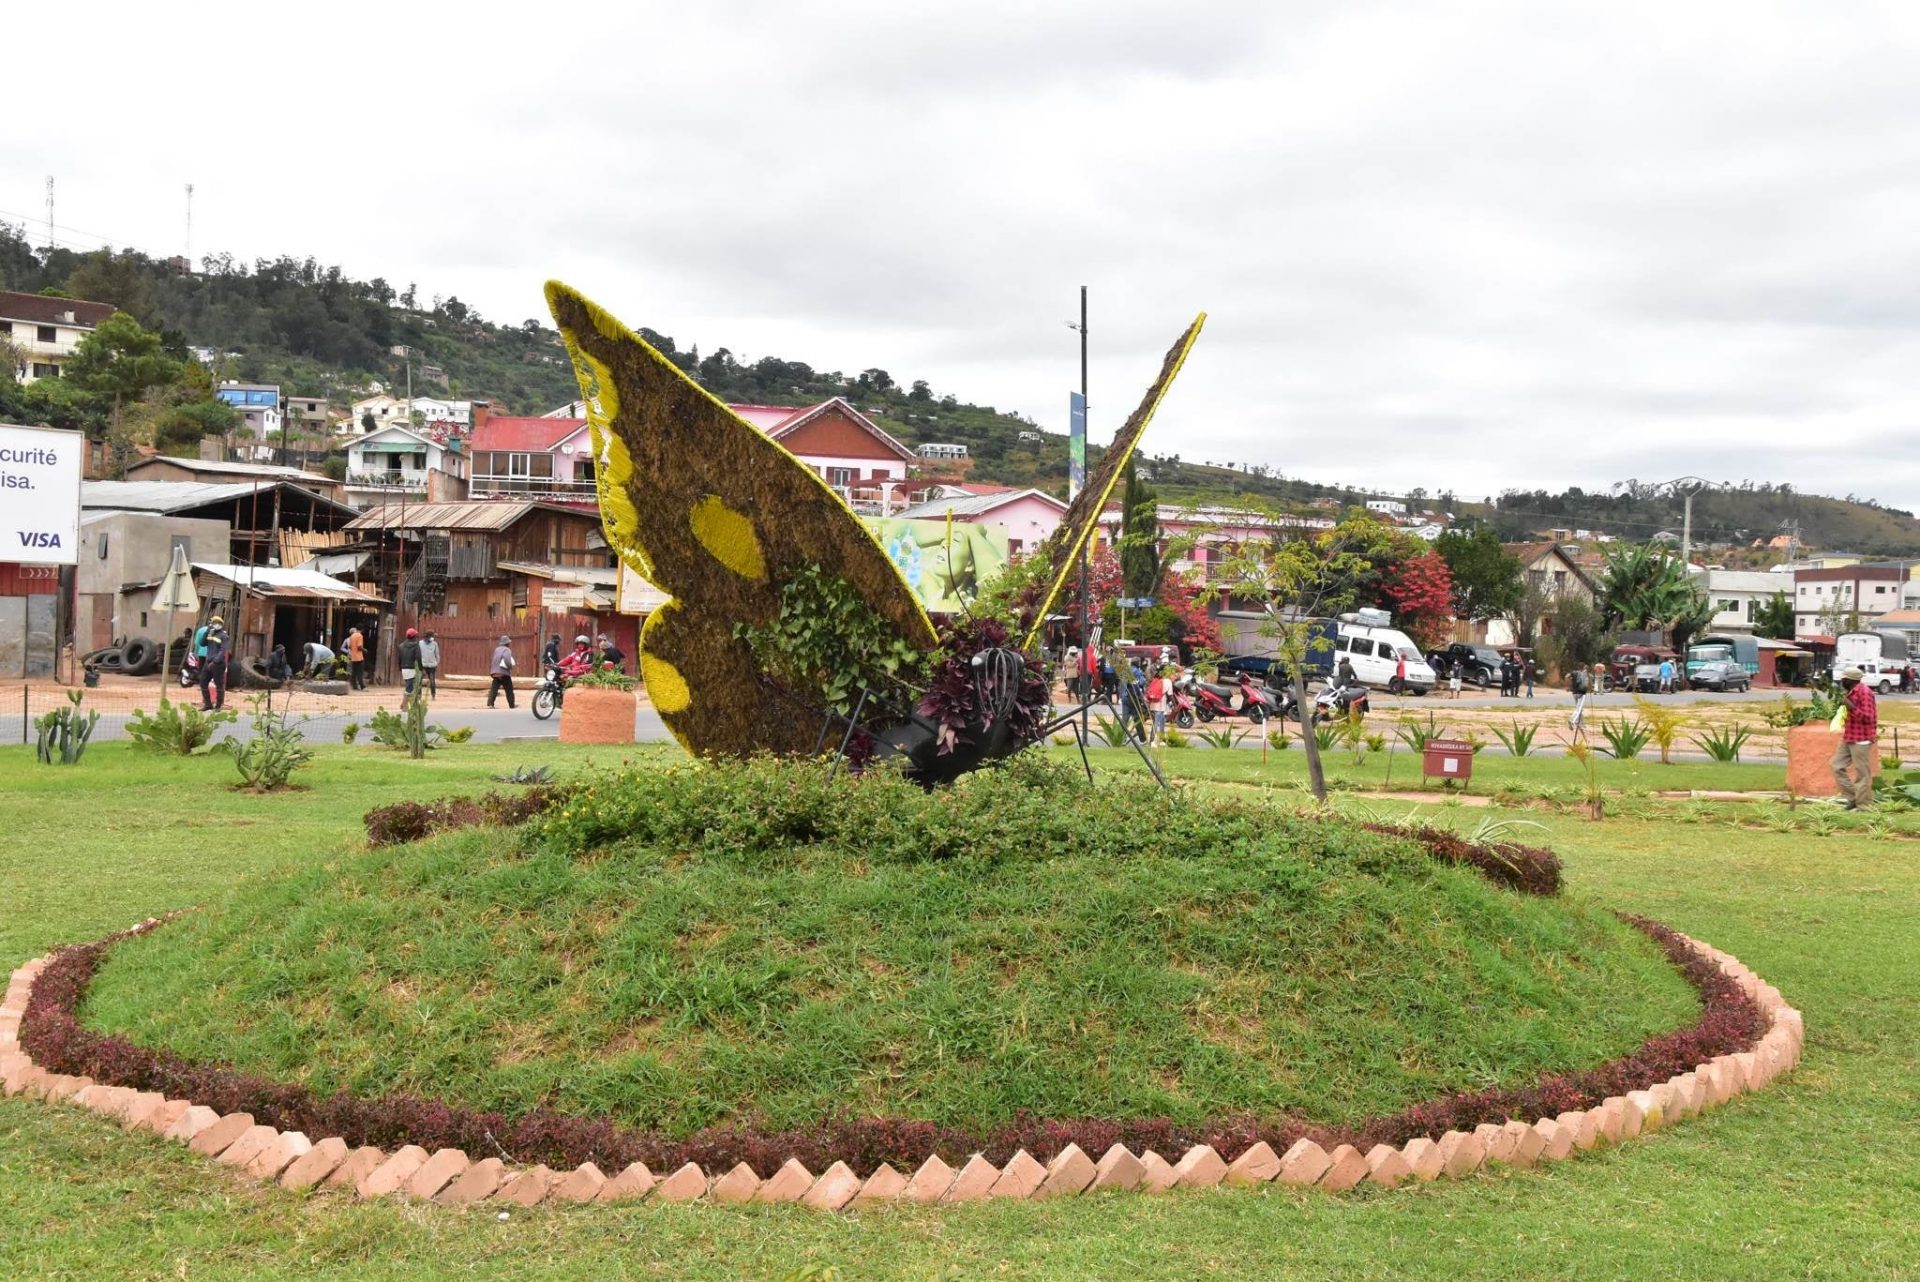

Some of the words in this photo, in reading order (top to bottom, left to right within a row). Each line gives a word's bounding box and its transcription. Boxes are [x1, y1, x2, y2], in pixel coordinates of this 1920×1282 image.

[0, 448, 57, 466] curité
[1, 470, 35, 489] isa.
[17, 531, 61, 548] VISA
